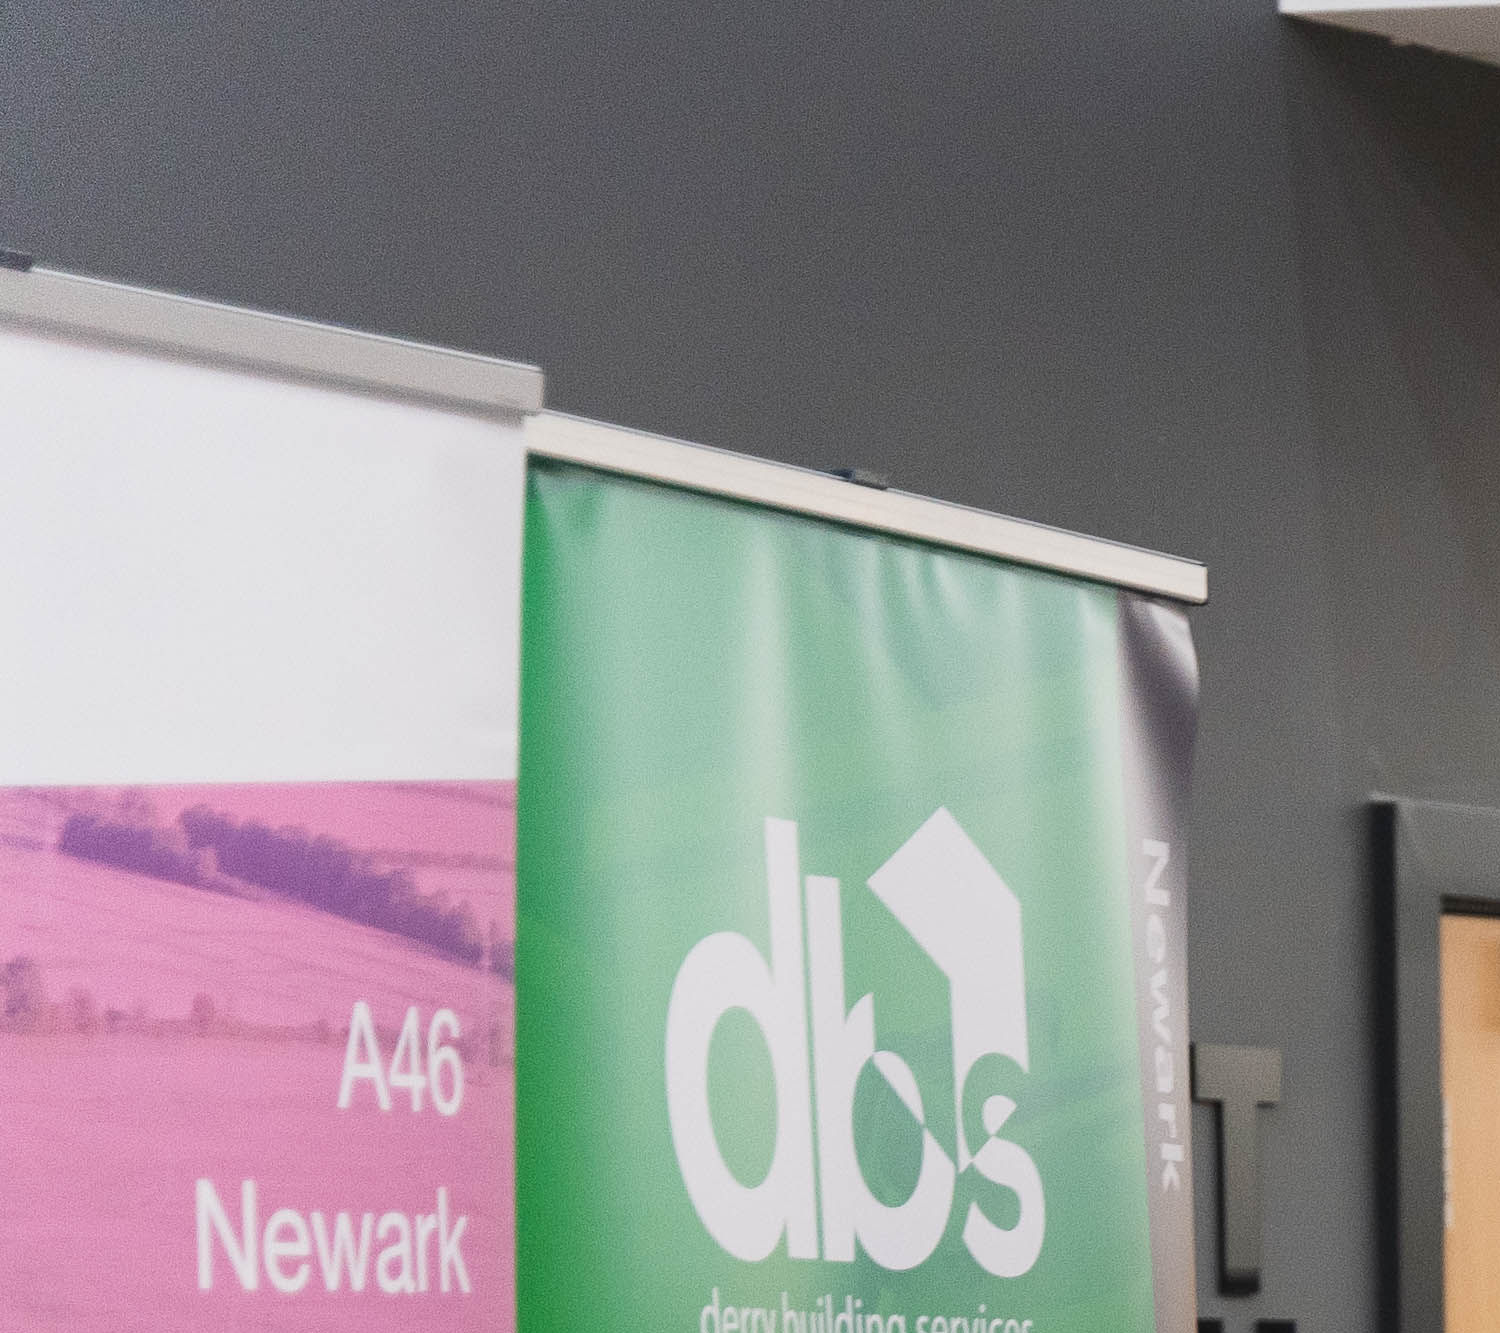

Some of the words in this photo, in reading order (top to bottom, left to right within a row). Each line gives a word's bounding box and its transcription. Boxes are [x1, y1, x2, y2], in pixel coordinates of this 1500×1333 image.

[337, 1001, 465, 1117] A46
[665, 803, 1047, 1279] dbs
[1140, 837, 1186, 1196] Newark
[195, 1177, 471, 1294] Newark
